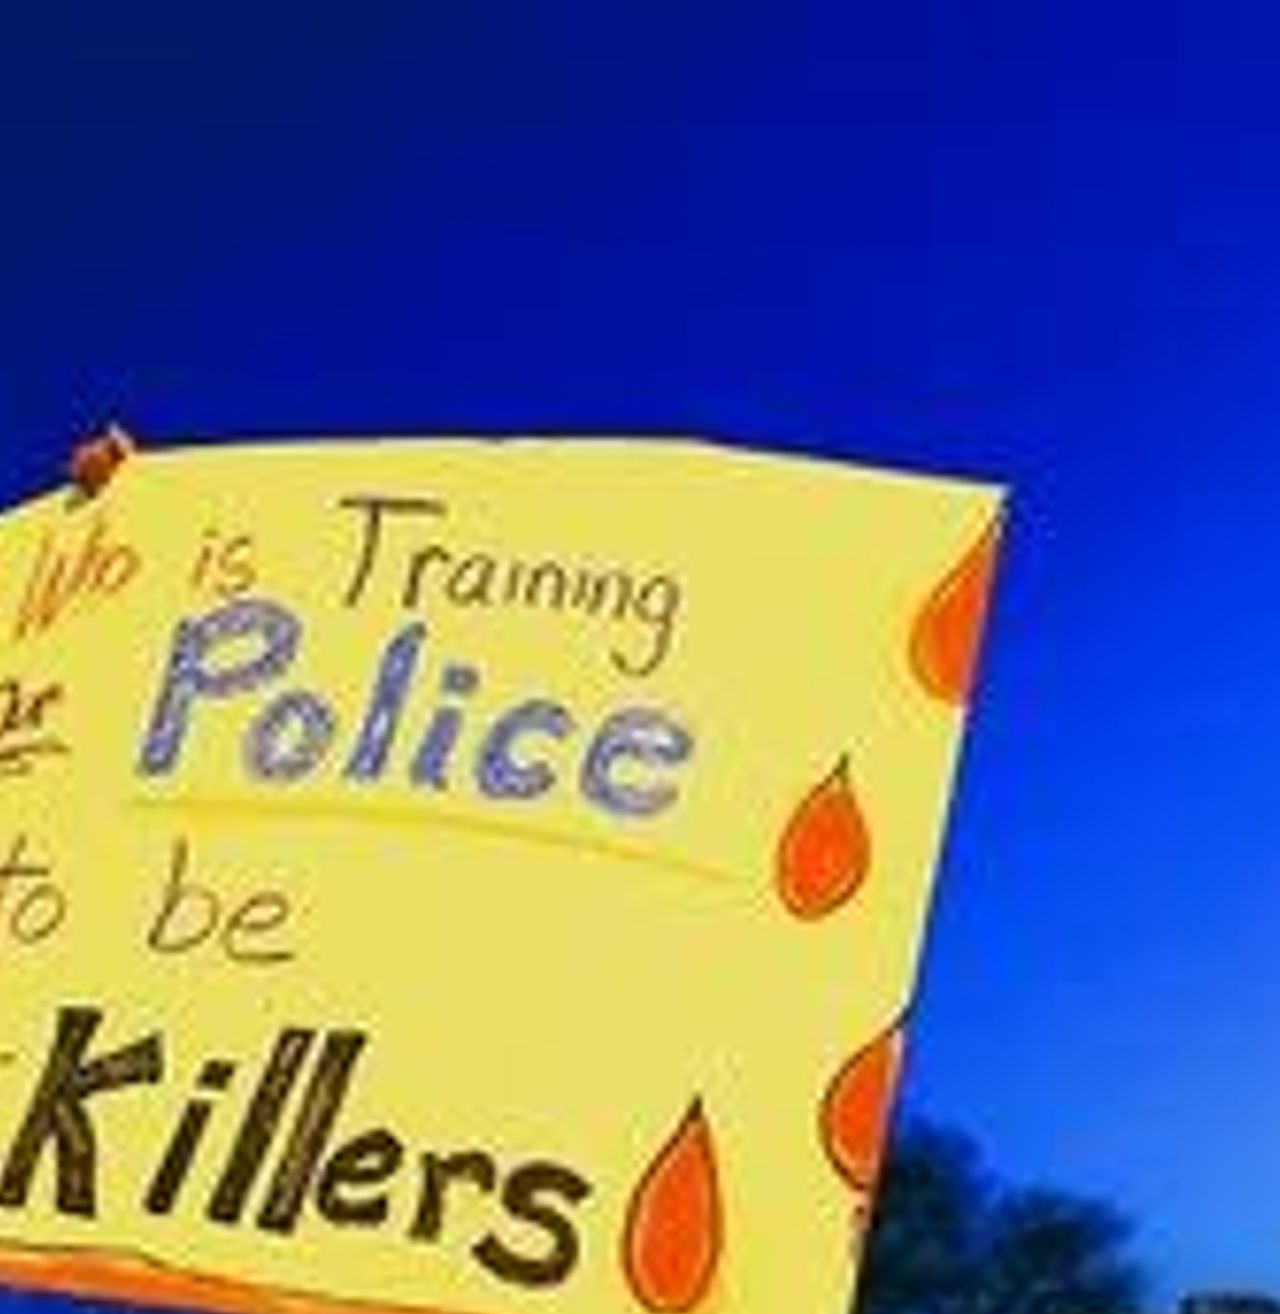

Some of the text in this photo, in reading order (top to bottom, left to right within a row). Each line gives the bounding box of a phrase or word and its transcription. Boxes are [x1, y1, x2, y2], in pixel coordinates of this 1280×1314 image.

[12, 496, 681, 679] Who is Training
[137, 597, 695, 818] Police
[147, 840, 293, 965] be
